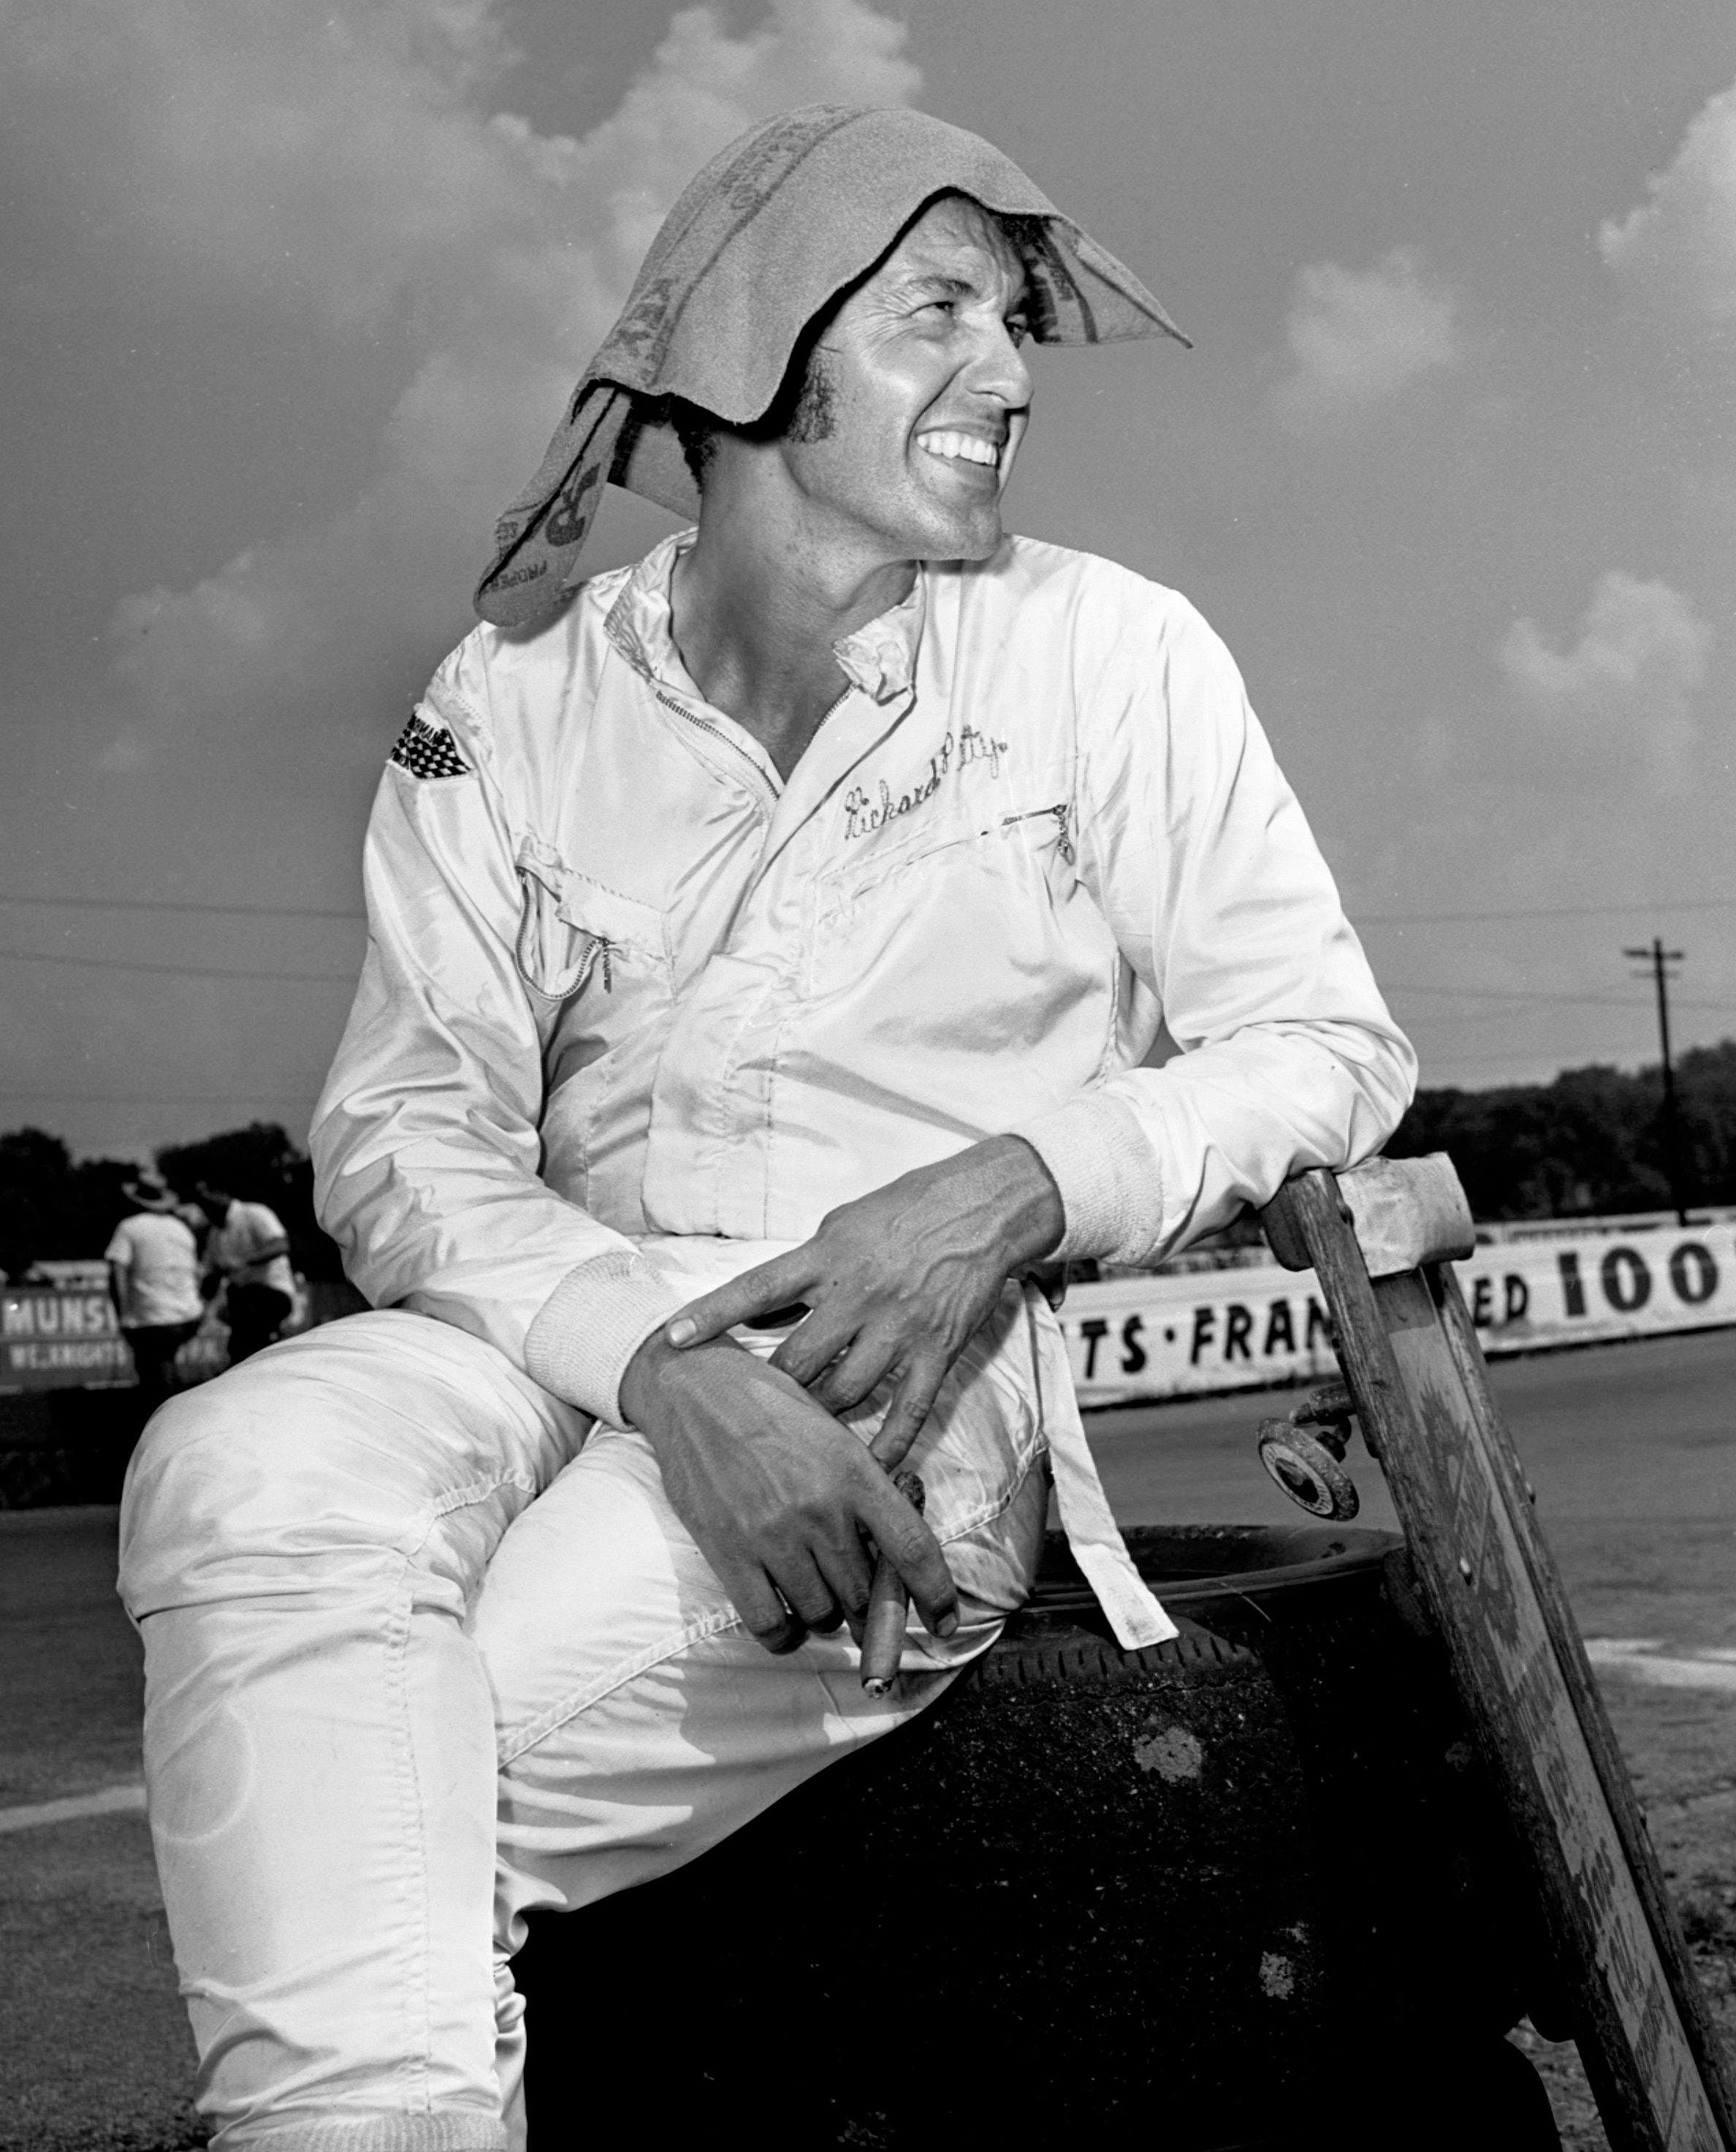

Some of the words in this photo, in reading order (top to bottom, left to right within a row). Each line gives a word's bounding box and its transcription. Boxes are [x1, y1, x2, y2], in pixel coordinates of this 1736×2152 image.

[844, 758, 941, 840] Richard
[938, 723, 1008, 780] Ptty
[1059, 1315, 1147, 1380] TS
